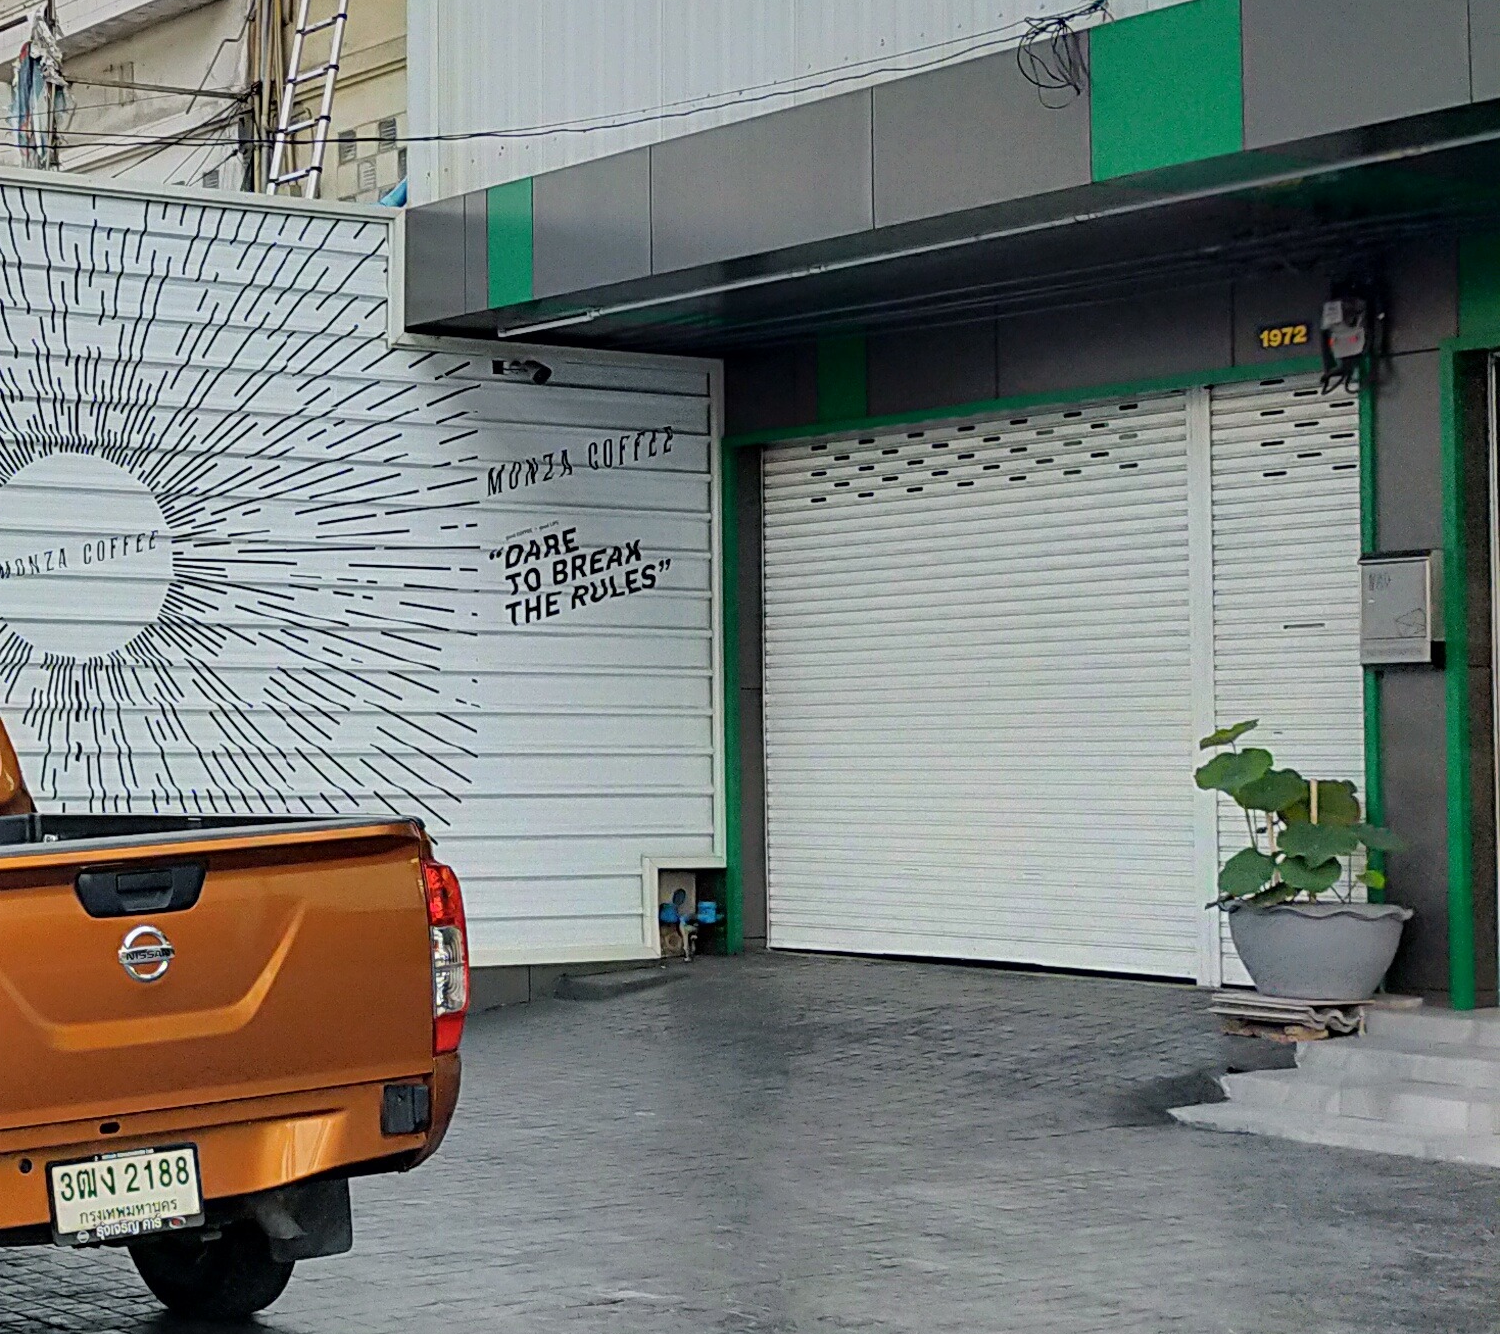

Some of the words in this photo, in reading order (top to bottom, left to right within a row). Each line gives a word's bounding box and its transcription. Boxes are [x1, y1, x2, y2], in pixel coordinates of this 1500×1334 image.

[1260, 324, 1308, 348] 1972
[487, 449, 573, 497] MONZA
[588, 425, 674, 471] COFFEE
[83, 529, 159, 565] COFFEE
[505, 567, 542, 596] TO
[552, 538, 643, 586] BREAK
[505, 590, 563, 627] THE
[125, 947, 171, 961] NISSAN
[60, 1166, 117, 1202] 3ฒง
[124, 1156, 190, 1194] 2188
[79, 1199, 178, 1227] กรุงเทพมหานคร
